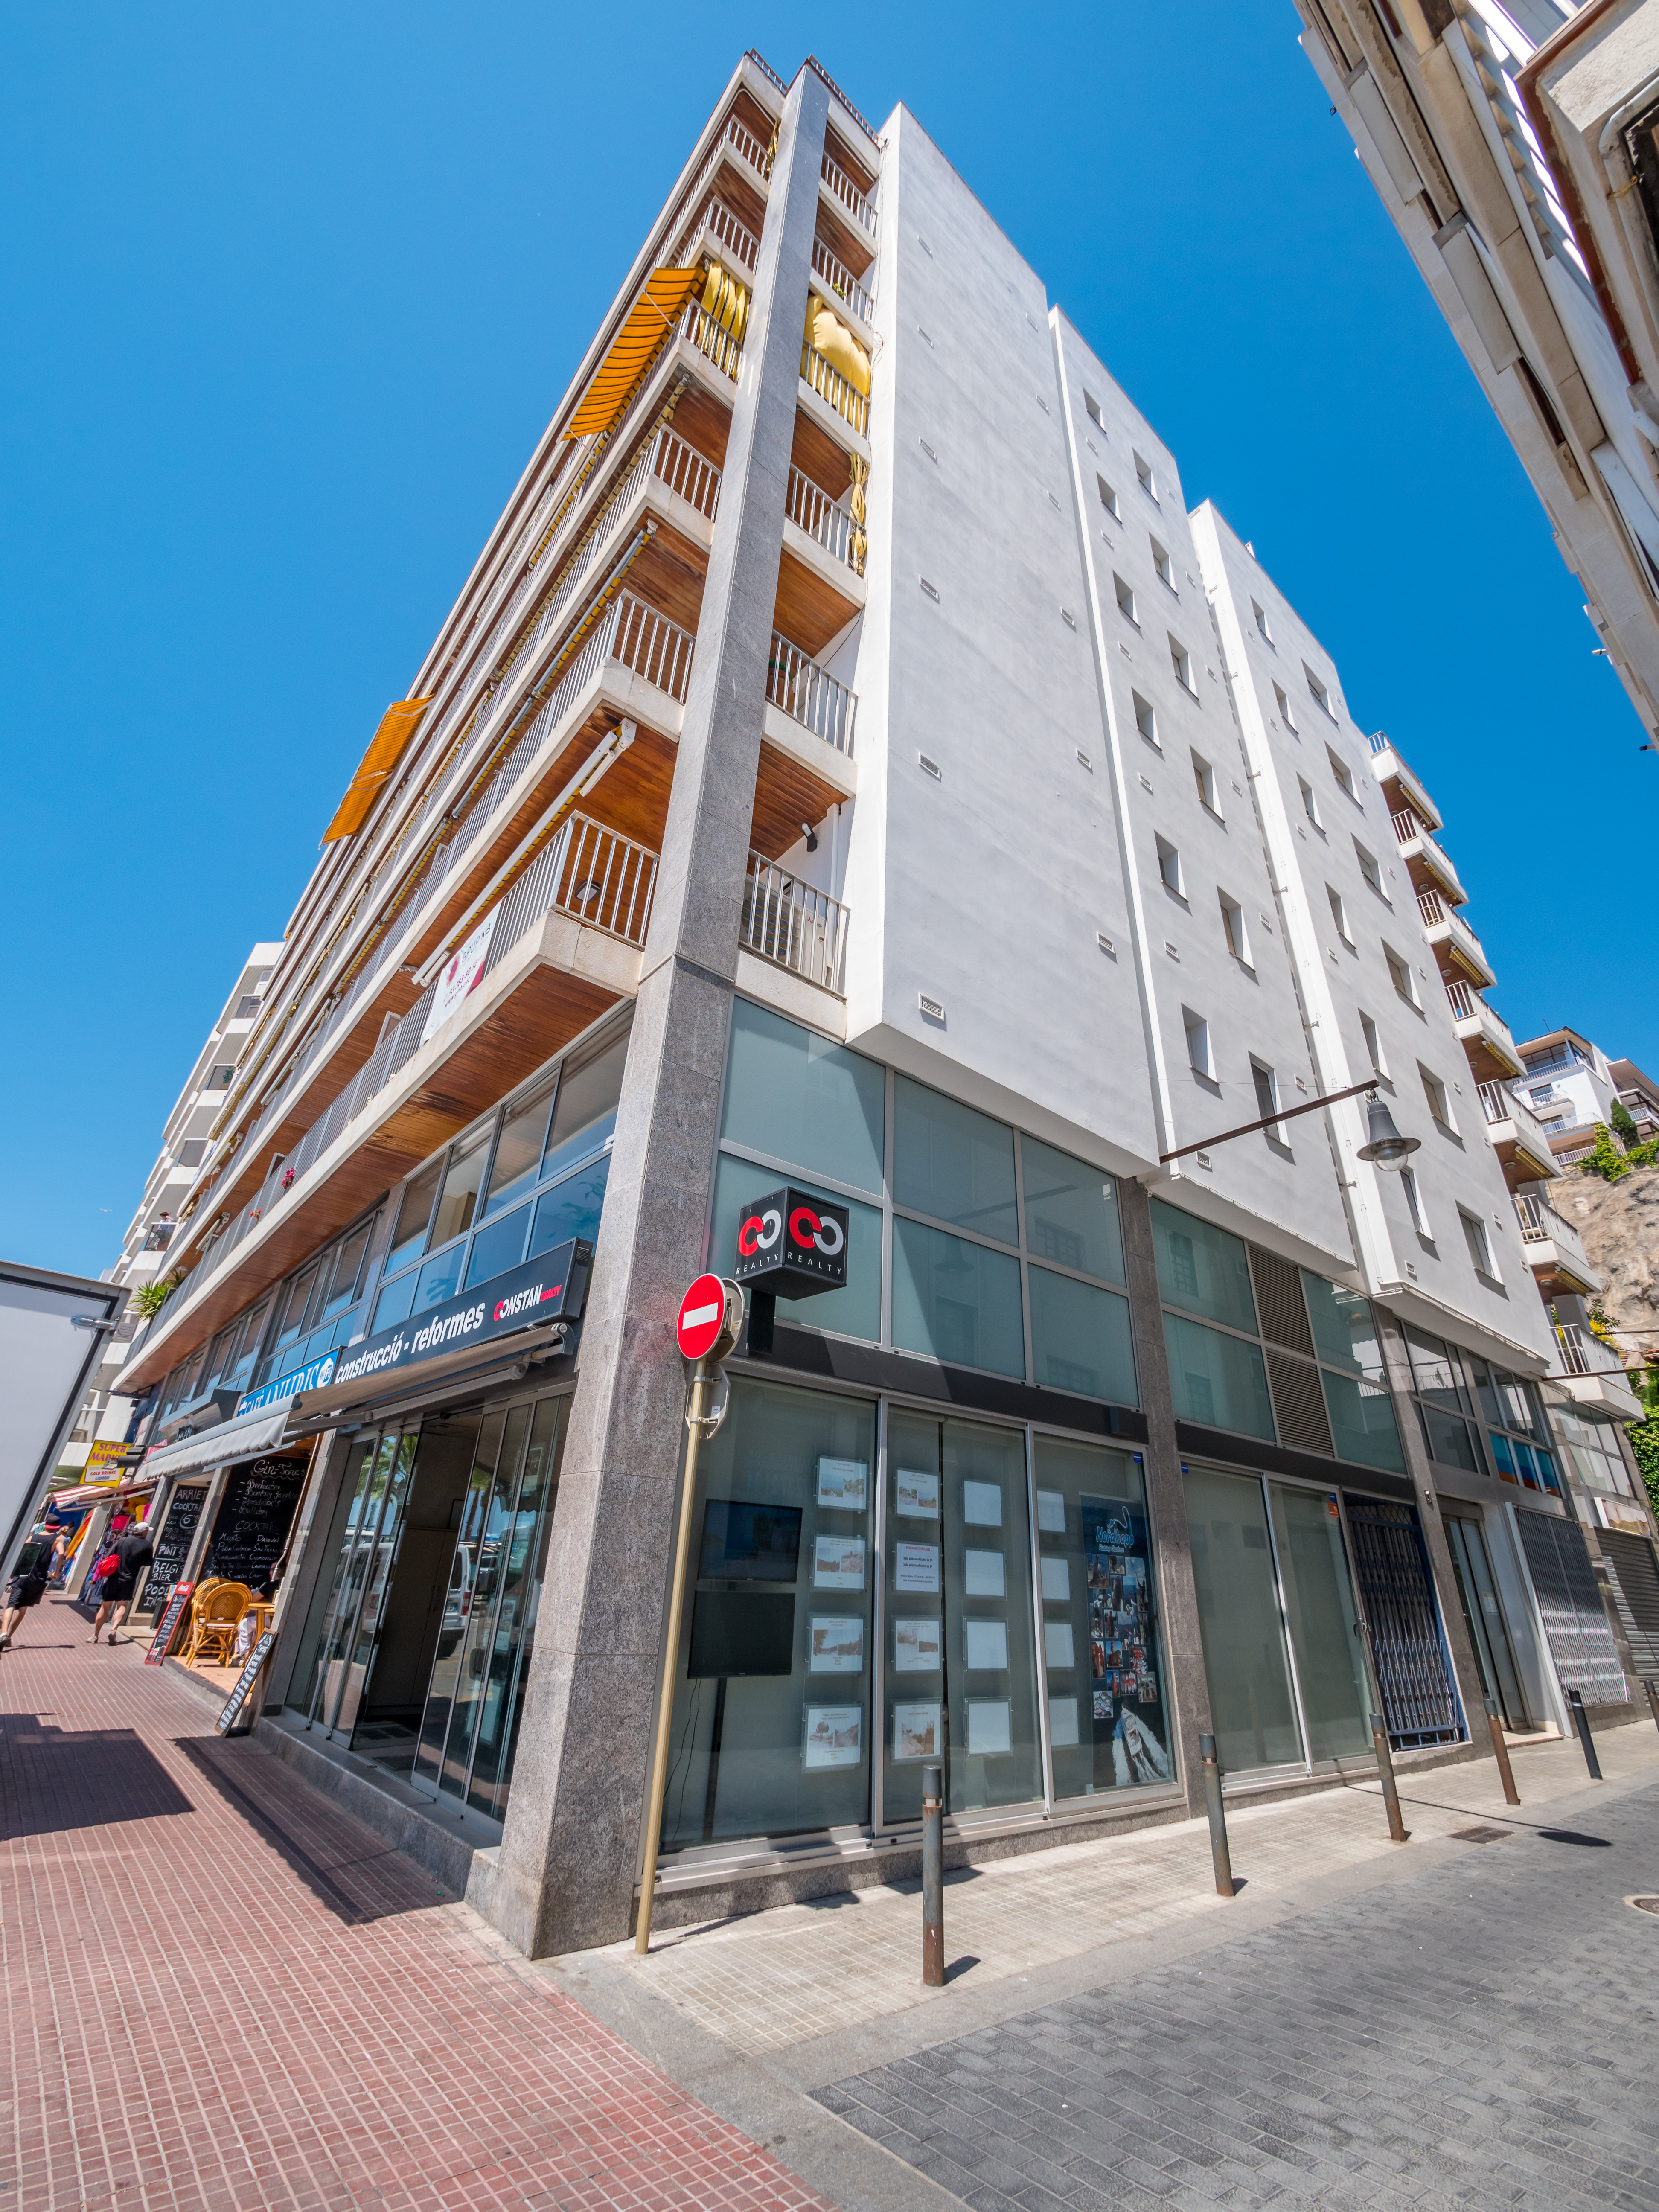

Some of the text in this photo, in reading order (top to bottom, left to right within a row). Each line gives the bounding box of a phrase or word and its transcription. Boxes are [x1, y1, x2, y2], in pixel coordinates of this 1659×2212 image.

[736, 1253, 779, 1275] REALTY
[788, 1252, 841, 1275] REALTY
[494, 1283, 562, 1321] CONSTAN REALTY
[335, 1331, 405, 1384] construcció
[411, 1302, 486, 1354] reformes
[99, 1443, 127, 1453] SUPER
[1096, 1526, 1135, 1548] Nordkapp
